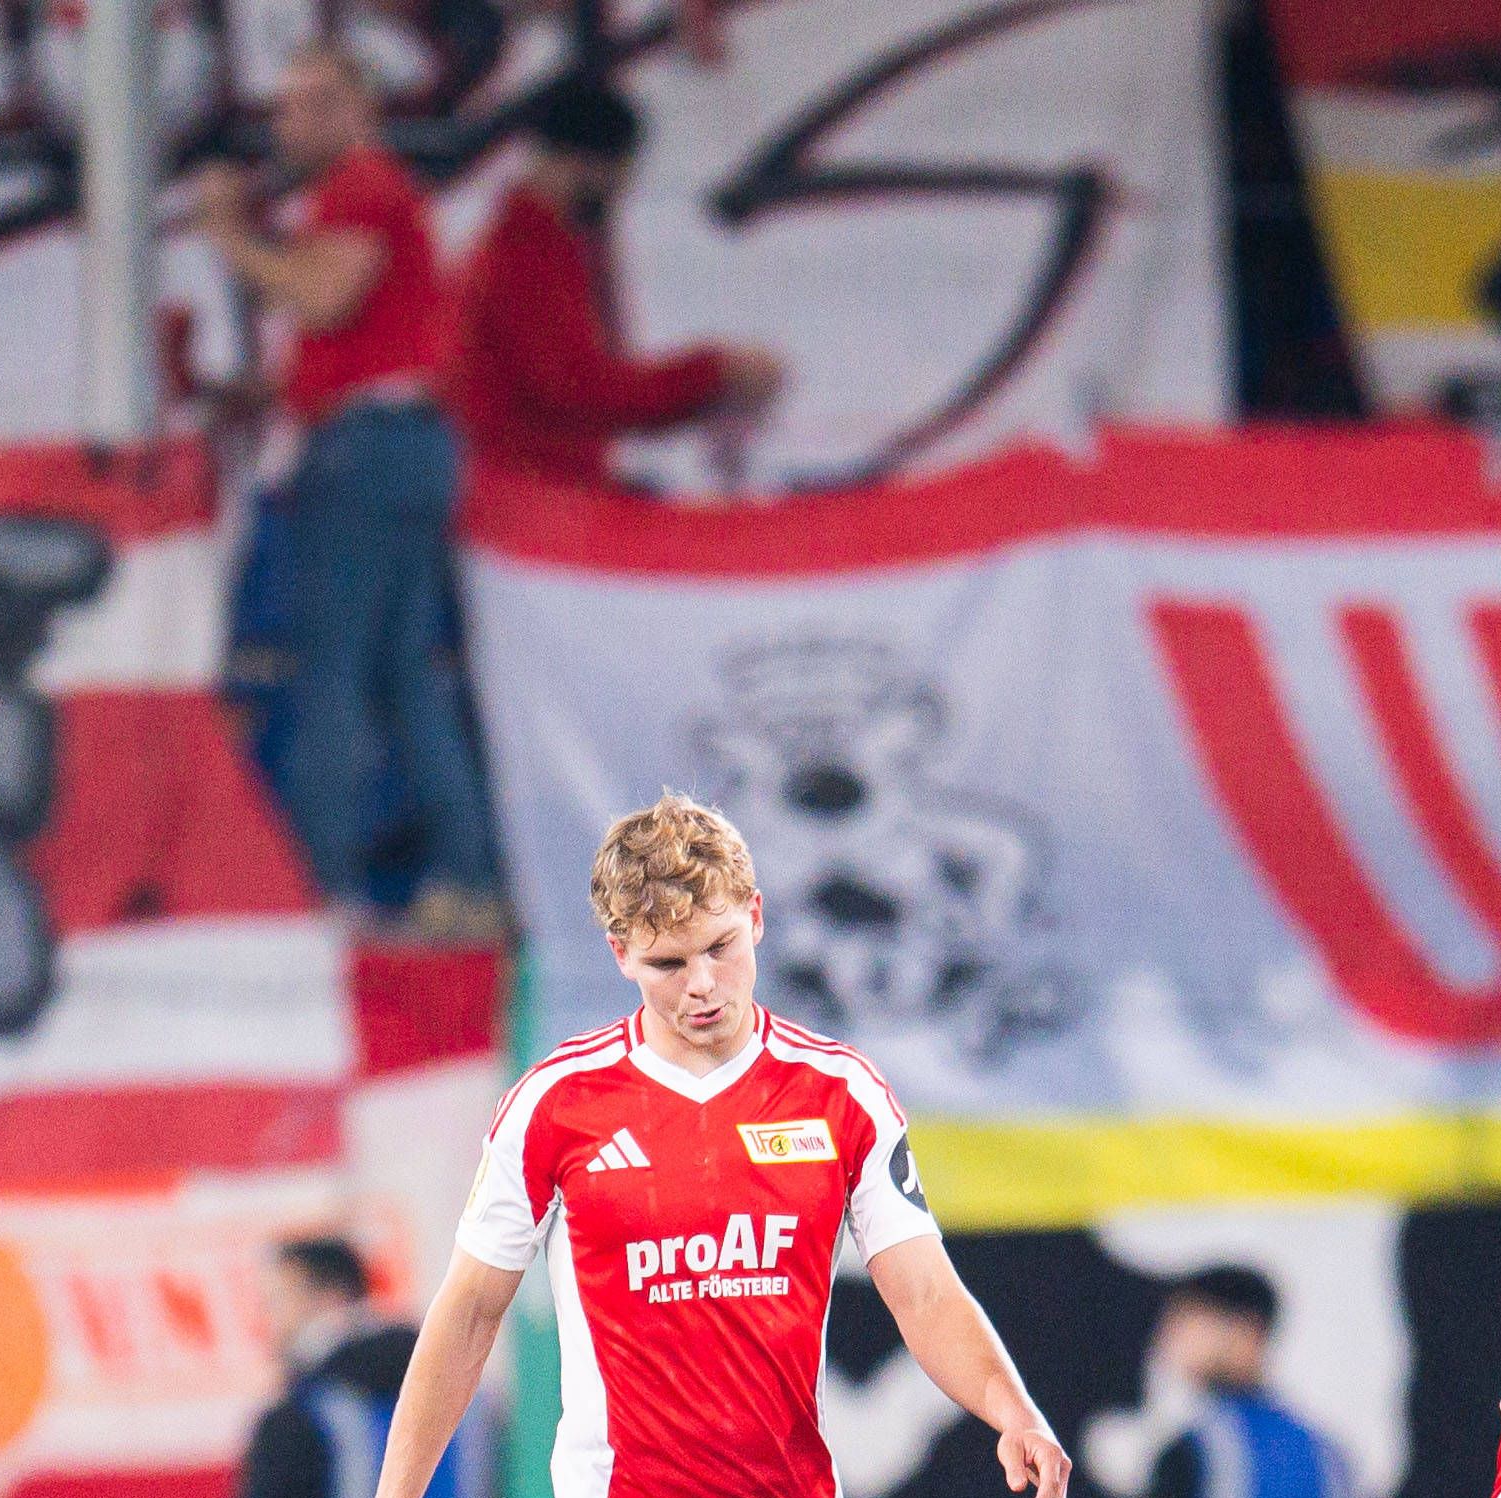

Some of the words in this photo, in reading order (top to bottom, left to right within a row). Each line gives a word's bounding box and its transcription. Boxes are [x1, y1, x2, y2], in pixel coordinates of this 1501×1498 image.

[792, 1135, 826, 1152] UNION
[626, 1213, 799, 1291] proAF
[648, 1280, 694, 1304] ALTE
[698, 1273, 790, 1299] FÖRSTEREI
